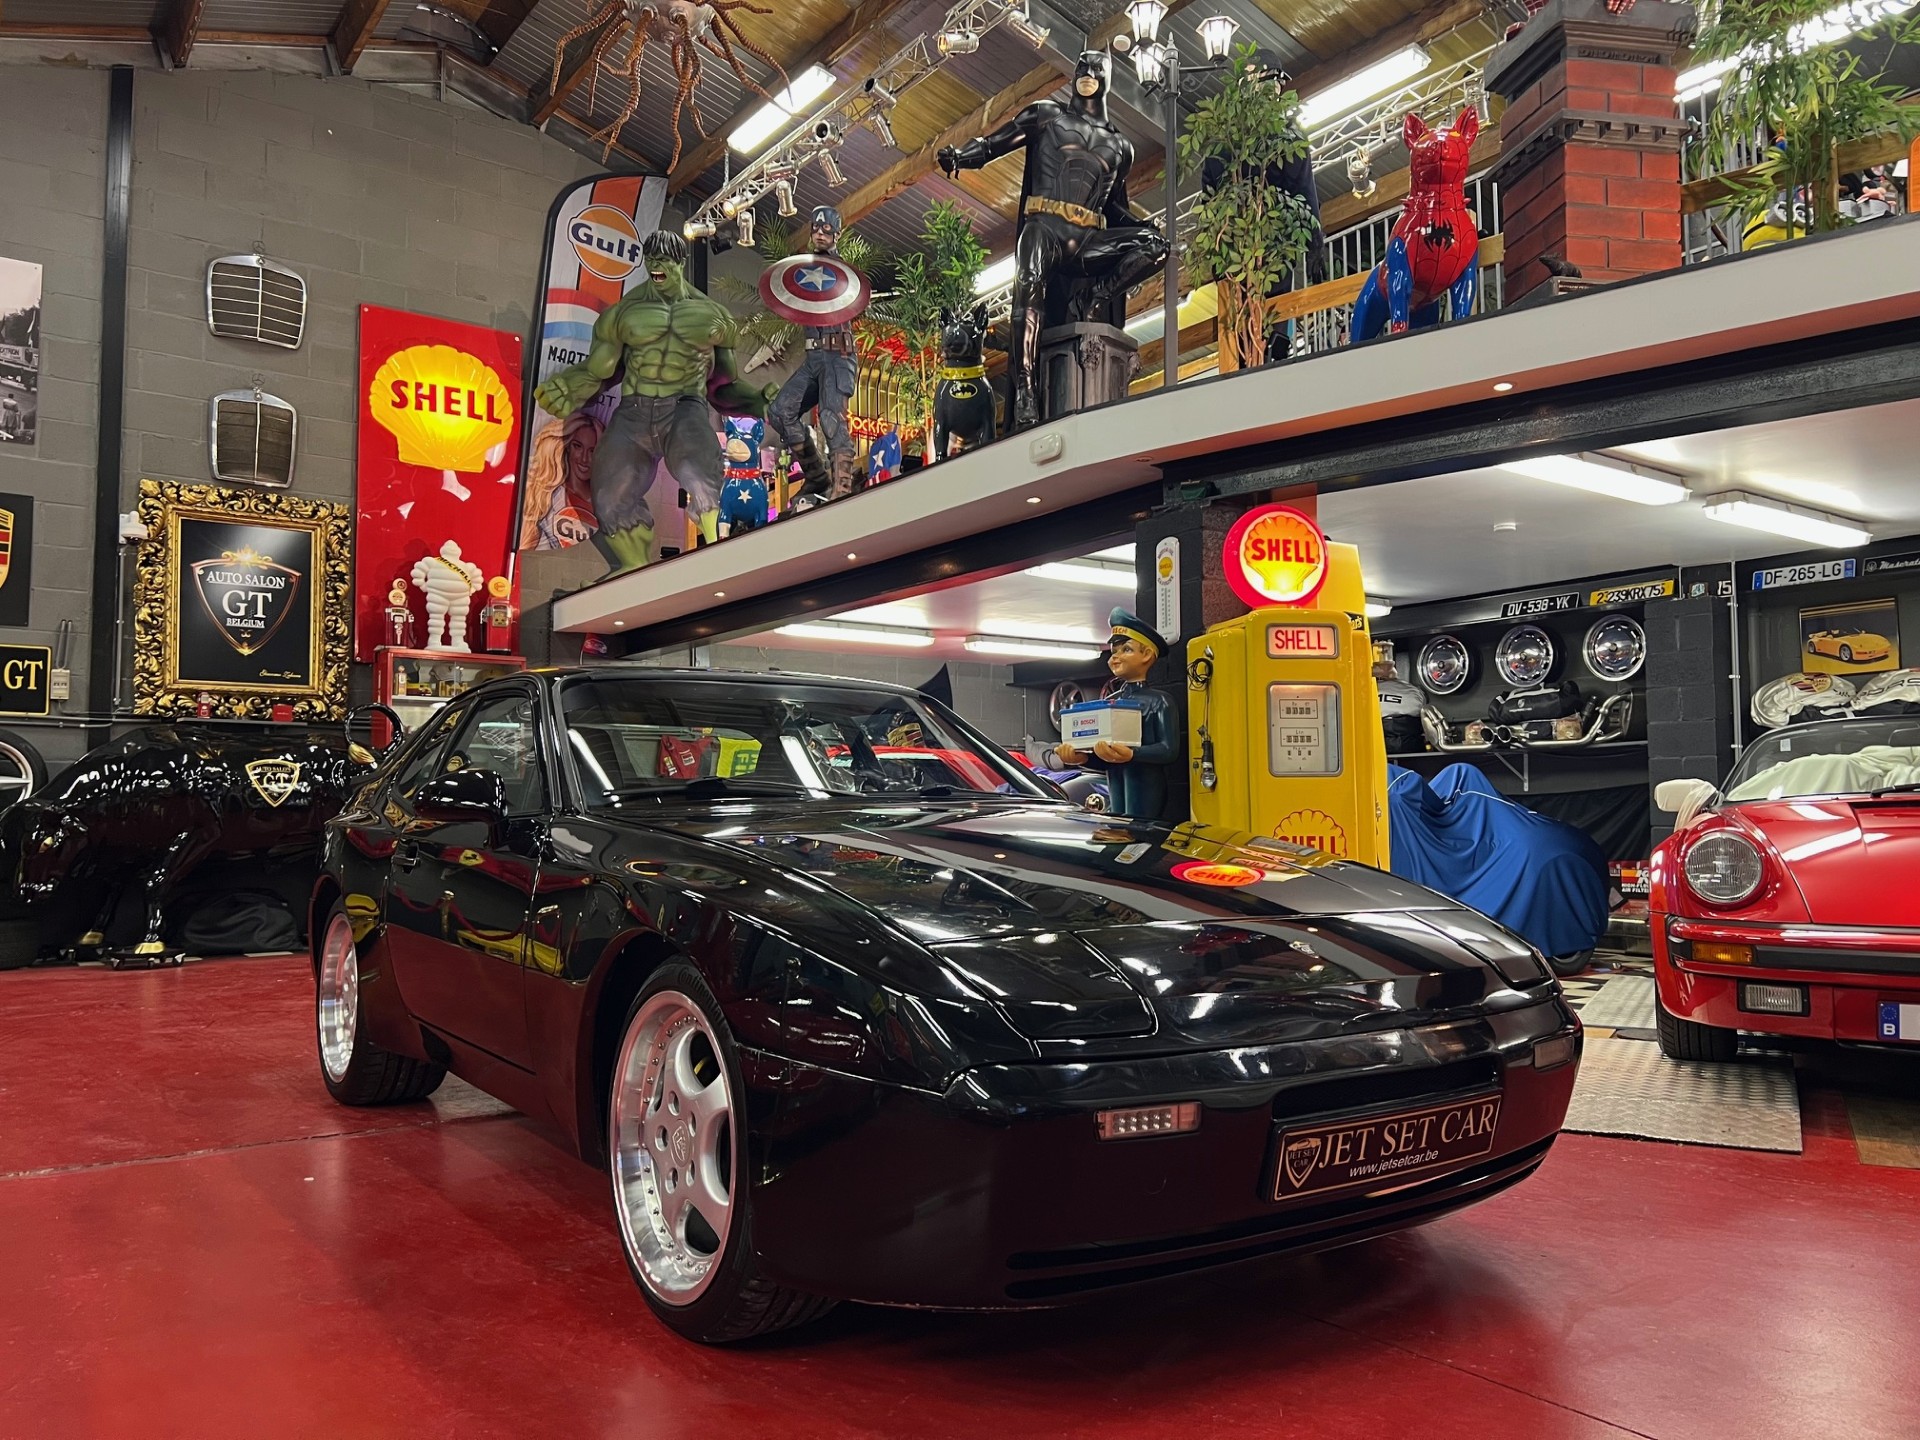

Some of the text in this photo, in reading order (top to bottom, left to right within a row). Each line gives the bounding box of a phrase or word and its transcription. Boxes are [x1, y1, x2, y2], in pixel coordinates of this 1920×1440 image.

[571, 222, 640, 263] Gulf
[547, 345, 589, 365] MART
[391, 380, 502, 425] SHELL
[1251, 538, 1315, 564] SHELL
[206, 571, 286, 588] AUTO SALON
[1764, 563, 1842, 586] DF-265-LG
[222, 590, 272, 618] GT
[226, 618, 265, 628] BELGIUM
[1275, 629, 1327, 650] SHELL
[3, 659, 43, 690] GT
[1884, 1023, 1896, 1036] B
[1319, 1103, 1495, 1169] JET SET CAR
[1349, 1150, 1439, 1178] www.jetsetcar.be
